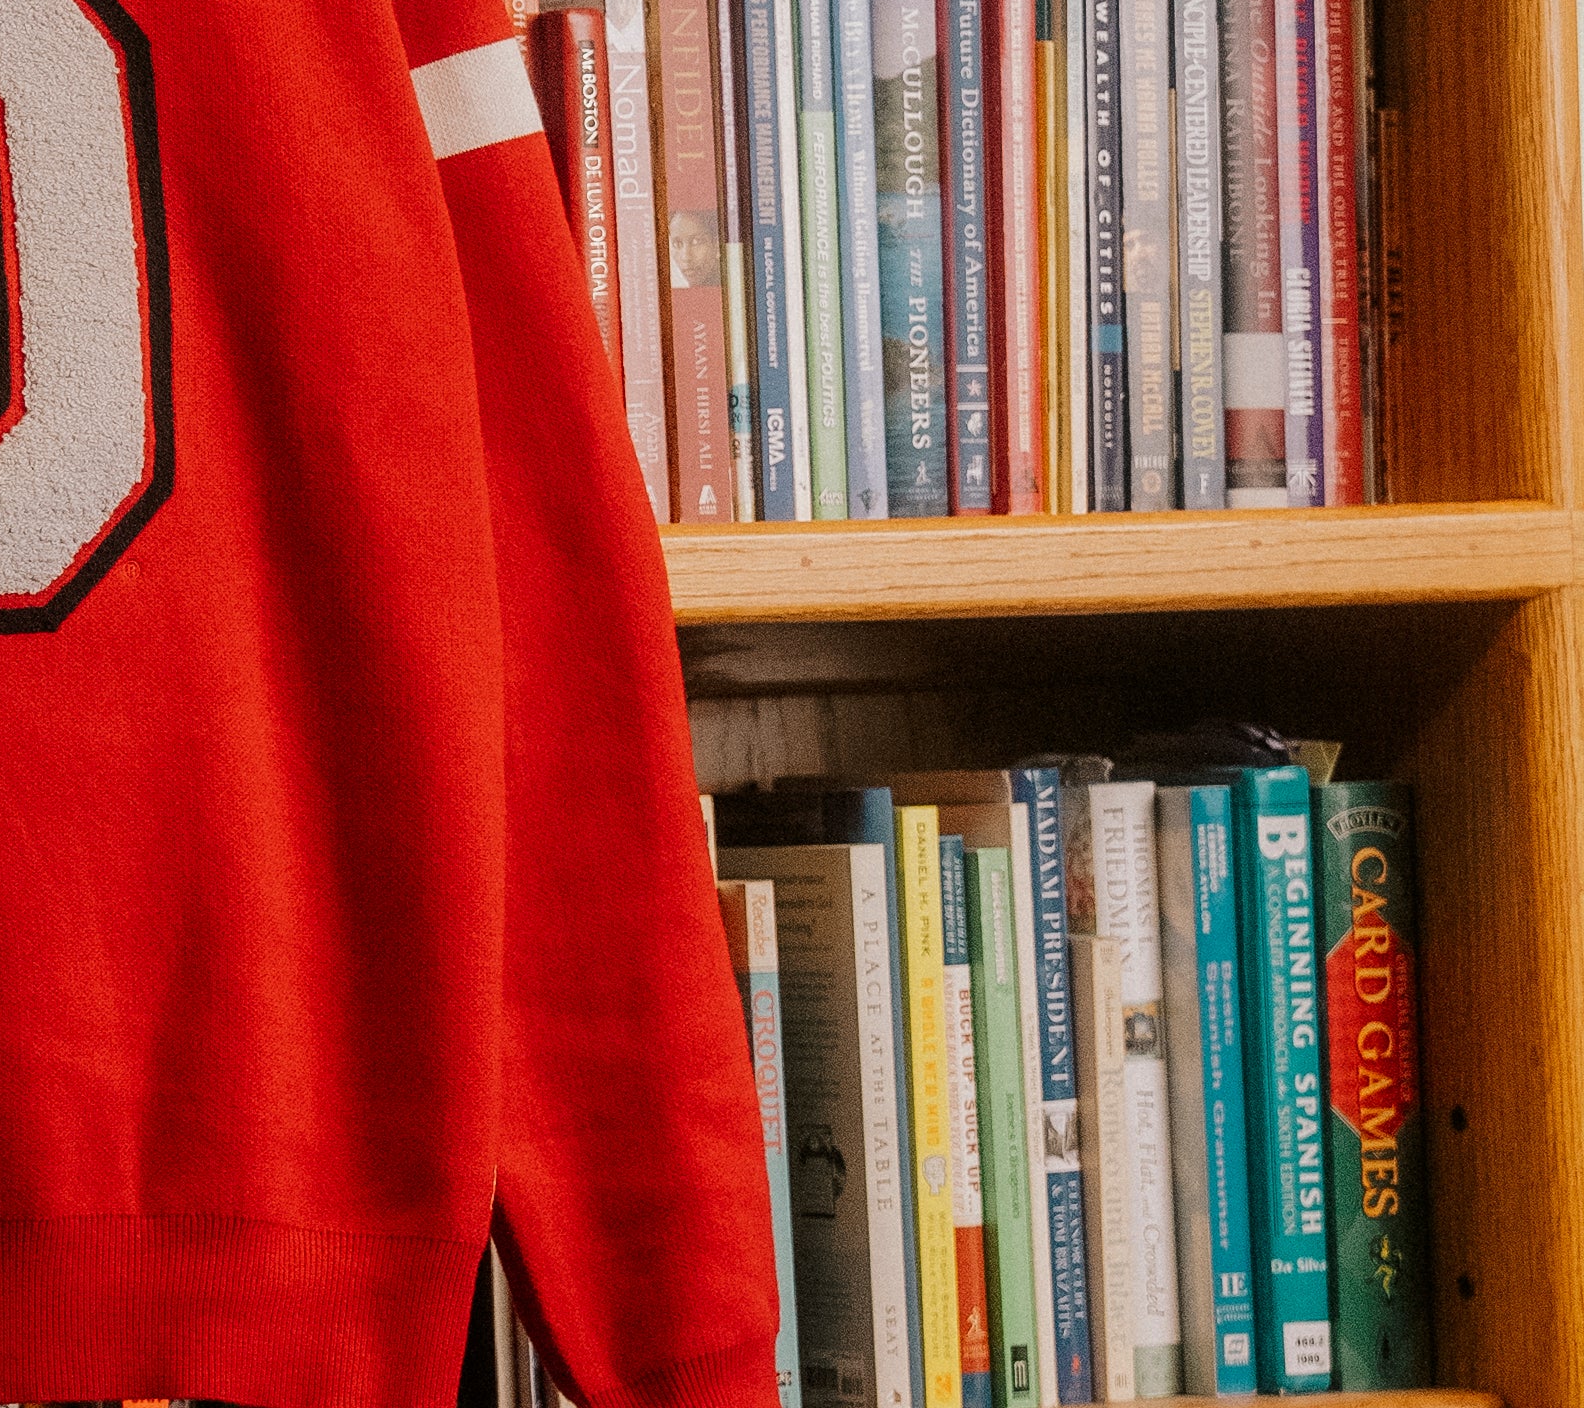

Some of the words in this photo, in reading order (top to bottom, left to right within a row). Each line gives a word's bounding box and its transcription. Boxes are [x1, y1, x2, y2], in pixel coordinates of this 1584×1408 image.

[956, 87, 981, 214] Dictionary
[909, 248, 921, 287] THE
[964, 222, 982, 248] of
[907, 296, 931, 449] PIONEERS
[964, 256, 984, 356] America
[1351, 846, 1392, 1003] CARD
[1257, 814, 1312, 1048] BEGINNING
[1295, 1073, 1323, 1235] SPANISH
[1357, 1021, 1398, 1217] GAMES
